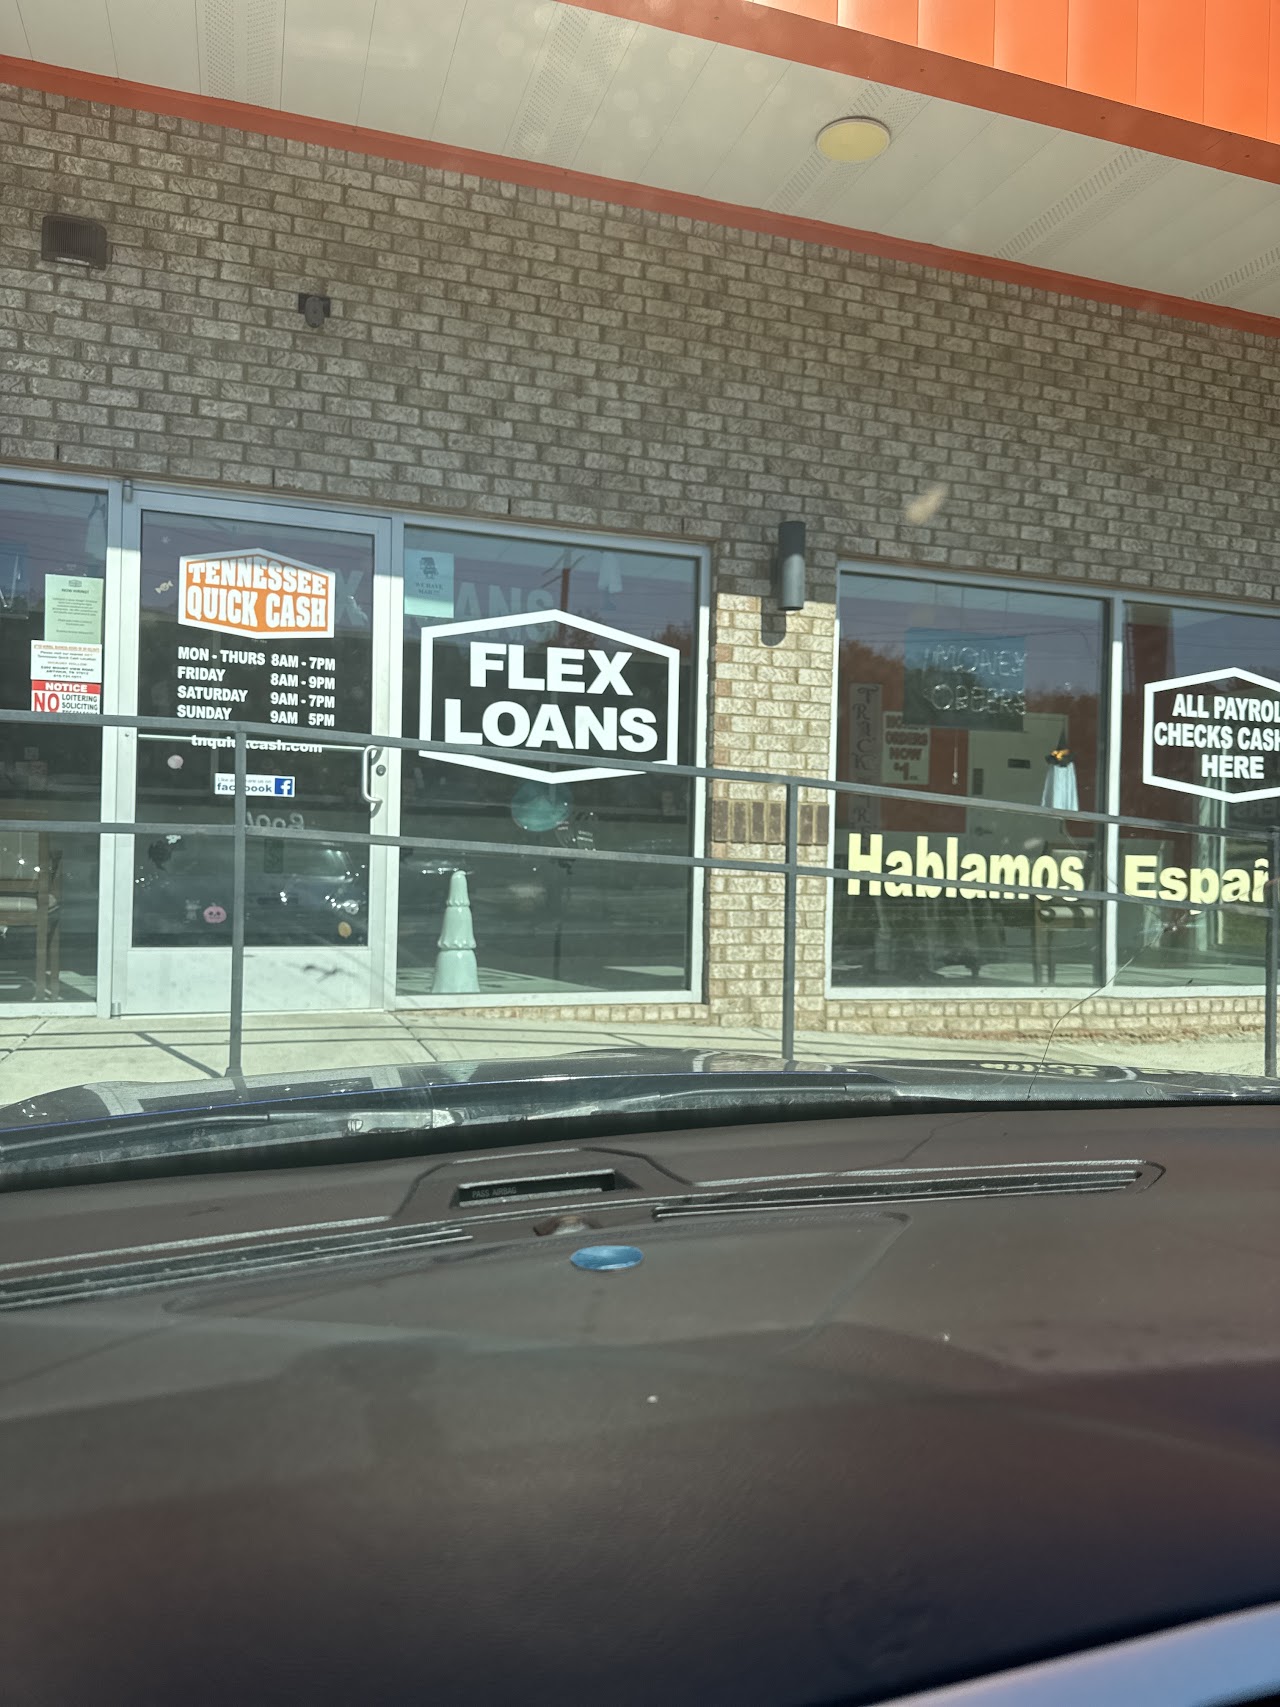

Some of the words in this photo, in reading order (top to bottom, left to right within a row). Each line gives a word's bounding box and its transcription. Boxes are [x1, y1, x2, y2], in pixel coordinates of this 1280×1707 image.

[188, 556, 327, 596] TENNESSEE
[186, 586, 258, 628] QUICK
[265, 593, 327, 629] CASH
[177, 646, 210, 661] MON
[220, 649, 266, 666] THURS
[271, 653, 299, 669] 8AM
[309, 657, 336, 672] 7PM
[470, 641, 634, 697] FLEX
[45, 682, 88, 693] NOTICE
[177, 666, 226, 682] FRIDAY
[270, 673, 298, 688] 8AM
[308, 675, 336, 690] 9PM
[34, 692, 60, 713] NO
[62, 694, 98, 703] LOITERING
[62, 702, 98, 711] SOLICITING
[177, 685, 249, 703] SATURDAY
[270, 692, 298, 707] 9AM
[308, 694, 336, 709] 7PM
[1172, 693, 1210, 719] ALL
[176, 704, 233, 720] SUNDAY
[270, 711, 298, 725] 9AM
[308, 713, 335, 727] 5PM
[444, 698, 659, 754] LOANS
[1154, 722, 1233, 750] CHECKS
[1201, 754, 1265, 780] HERE
[847, 832, 1085, 902] Hablamos
[472, 1189, 490, 1199] PASS
[492, 1186, 517, 1196] AIRBAG
